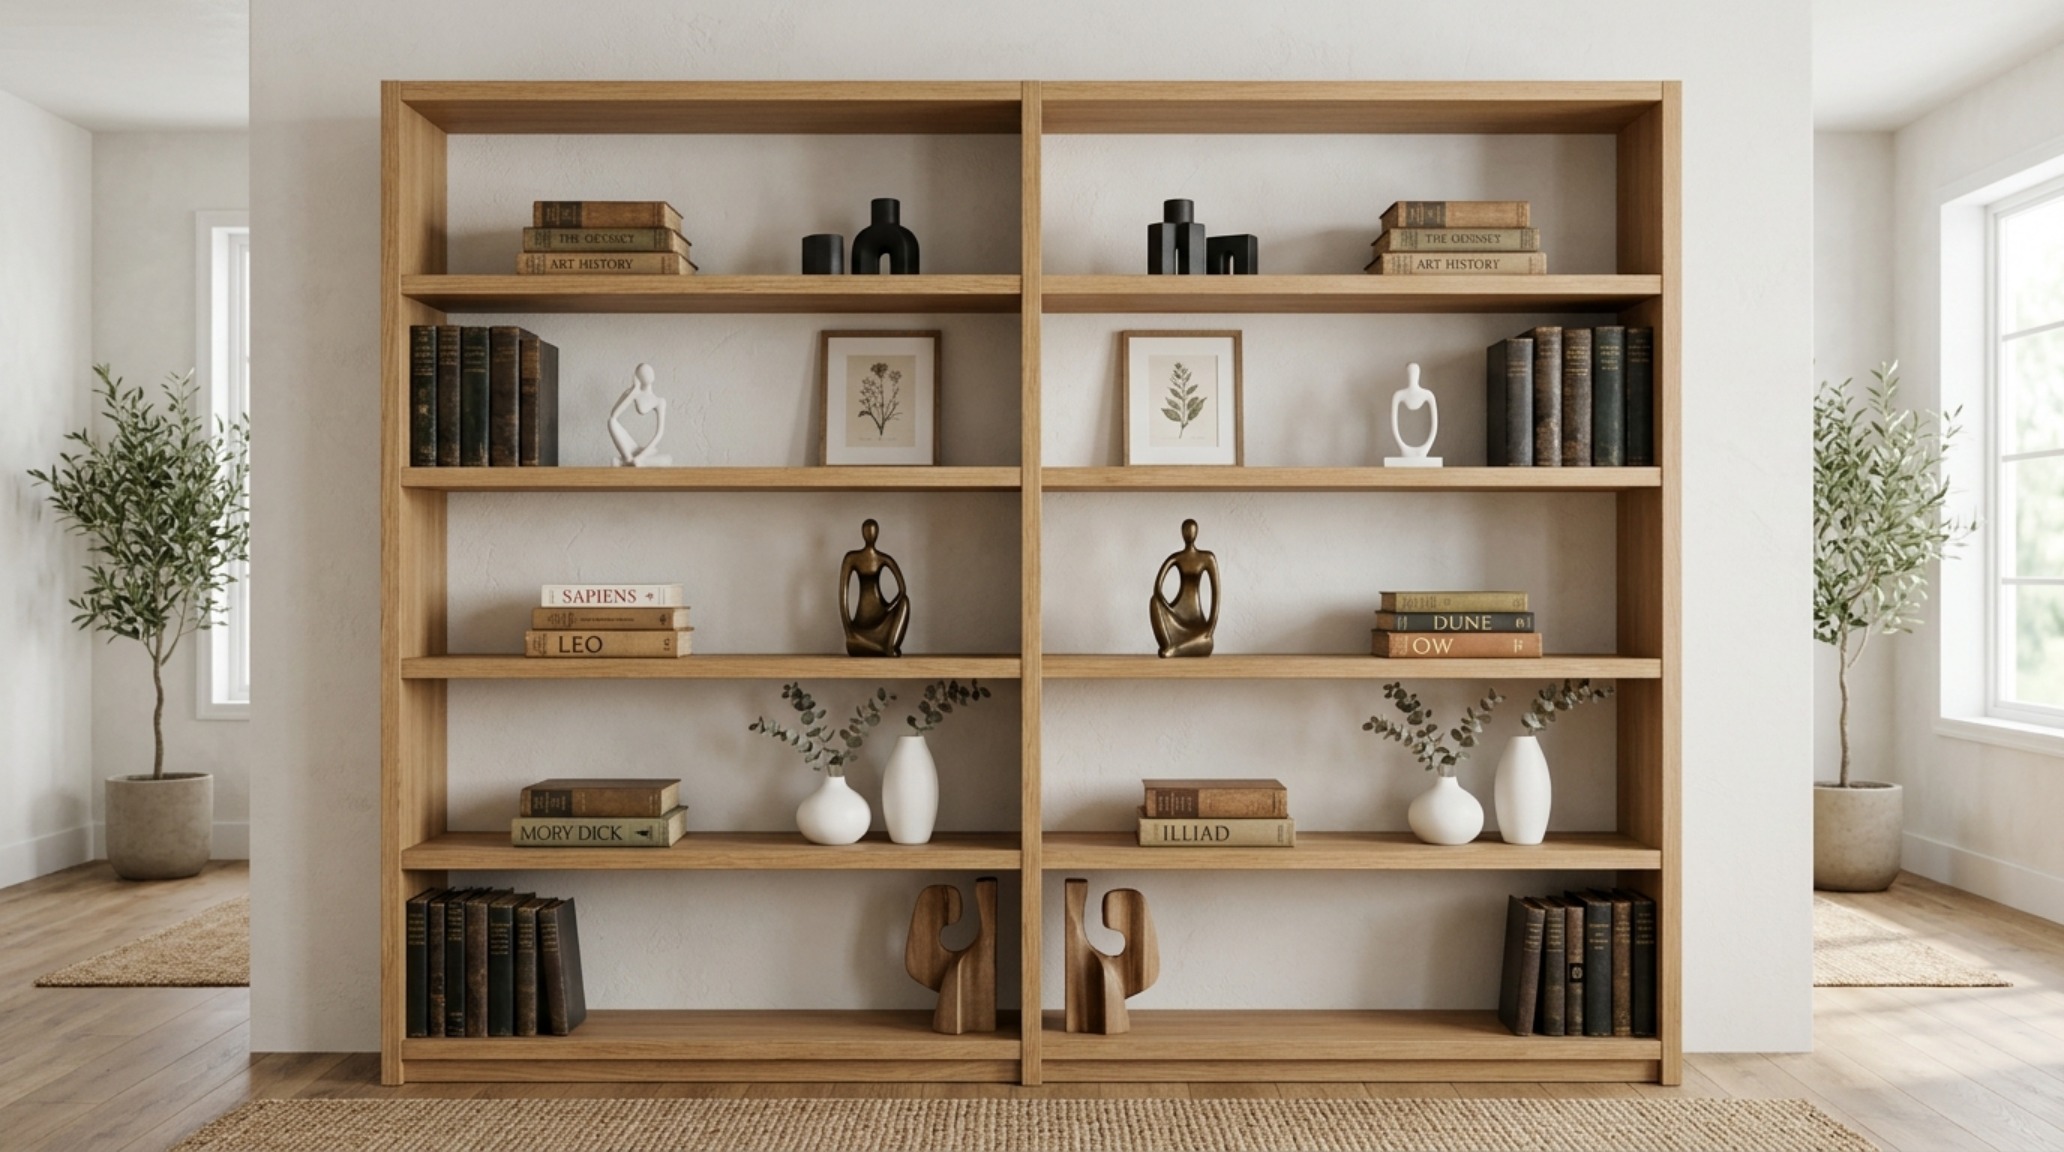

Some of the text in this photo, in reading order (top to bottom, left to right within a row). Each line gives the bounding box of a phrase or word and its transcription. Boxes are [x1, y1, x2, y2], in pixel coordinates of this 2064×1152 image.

[550, 259, 634, 270] ART HISTORY
[1417, 259, 1501, 270] ART HISTORY
[562, 589, 637, 604] SAPIENS
[1433, 615, 1493, 631] DUNE
[559, 636, 604, 654] LEO
[1412, 637, 1454, 655] OW
[519, 825, 623, 841] MORY DICK
[1163, 825, 1231, 842] ILLIAD
